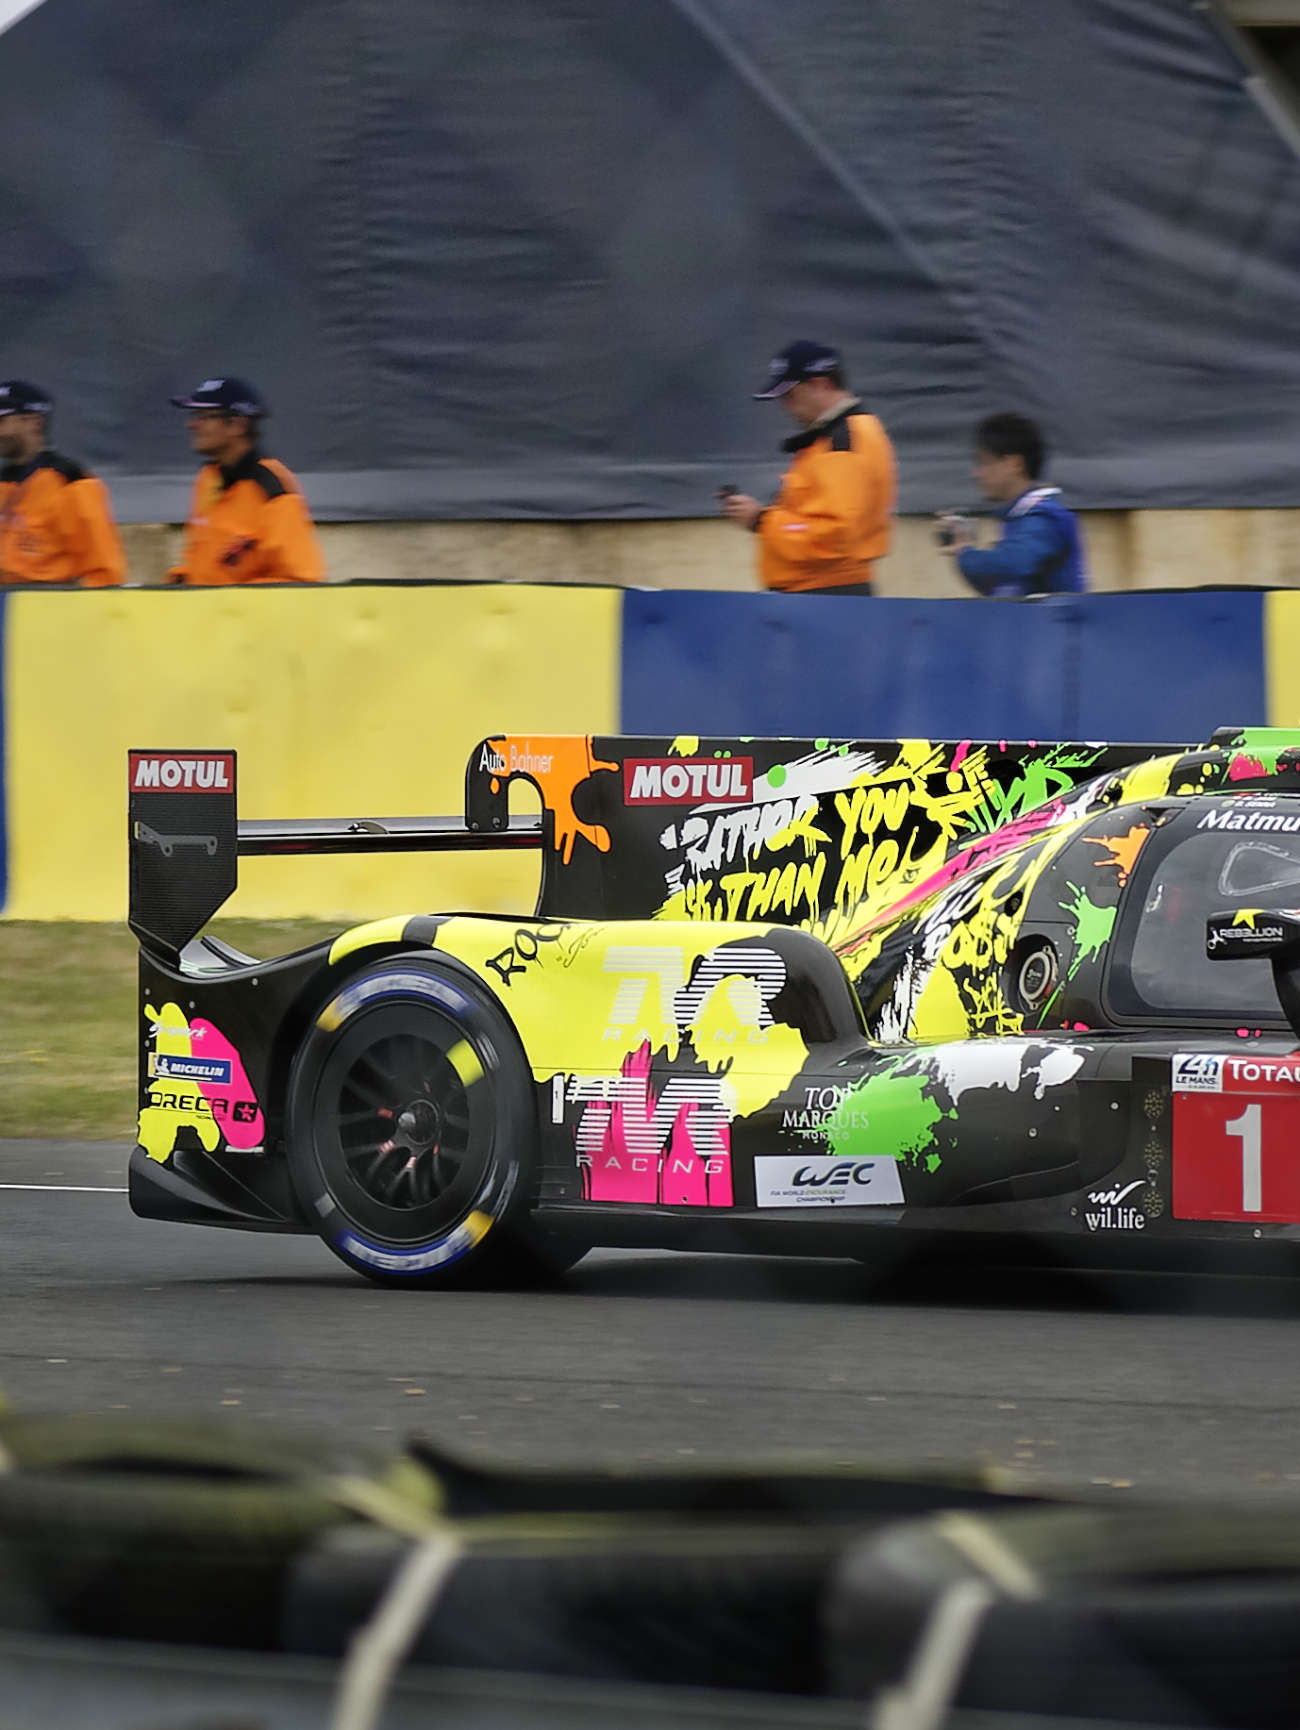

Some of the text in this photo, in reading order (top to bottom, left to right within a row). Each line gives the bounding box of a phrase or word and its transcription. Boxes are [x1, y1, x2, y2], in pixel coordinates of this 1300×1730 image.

[479, 743, 506, 772] Auto
[134, 759, 229, 788] MOTUL
[630, 764, 748, 798] MOTUL
[1219, 927, 1284, 938] REBELLION
[601, 1028, 770, 1045] RACING
[170, 1062, 225, 1077] MICHELIN
[1175, 1076, 1217, 1085] LE MANS
[148, 1091, 229, 1114] ORECA
[804, 1087, 852, 1111] TOP
[782, 1109, 869, 1129] MARQUES
[575, 1154, 724, 1175] RACING
[1226, 1104, 1261, 1212] 1
[792, 1162, 876, 1187] WEC
[1085, 1207, 1145, 1232] wil.life
